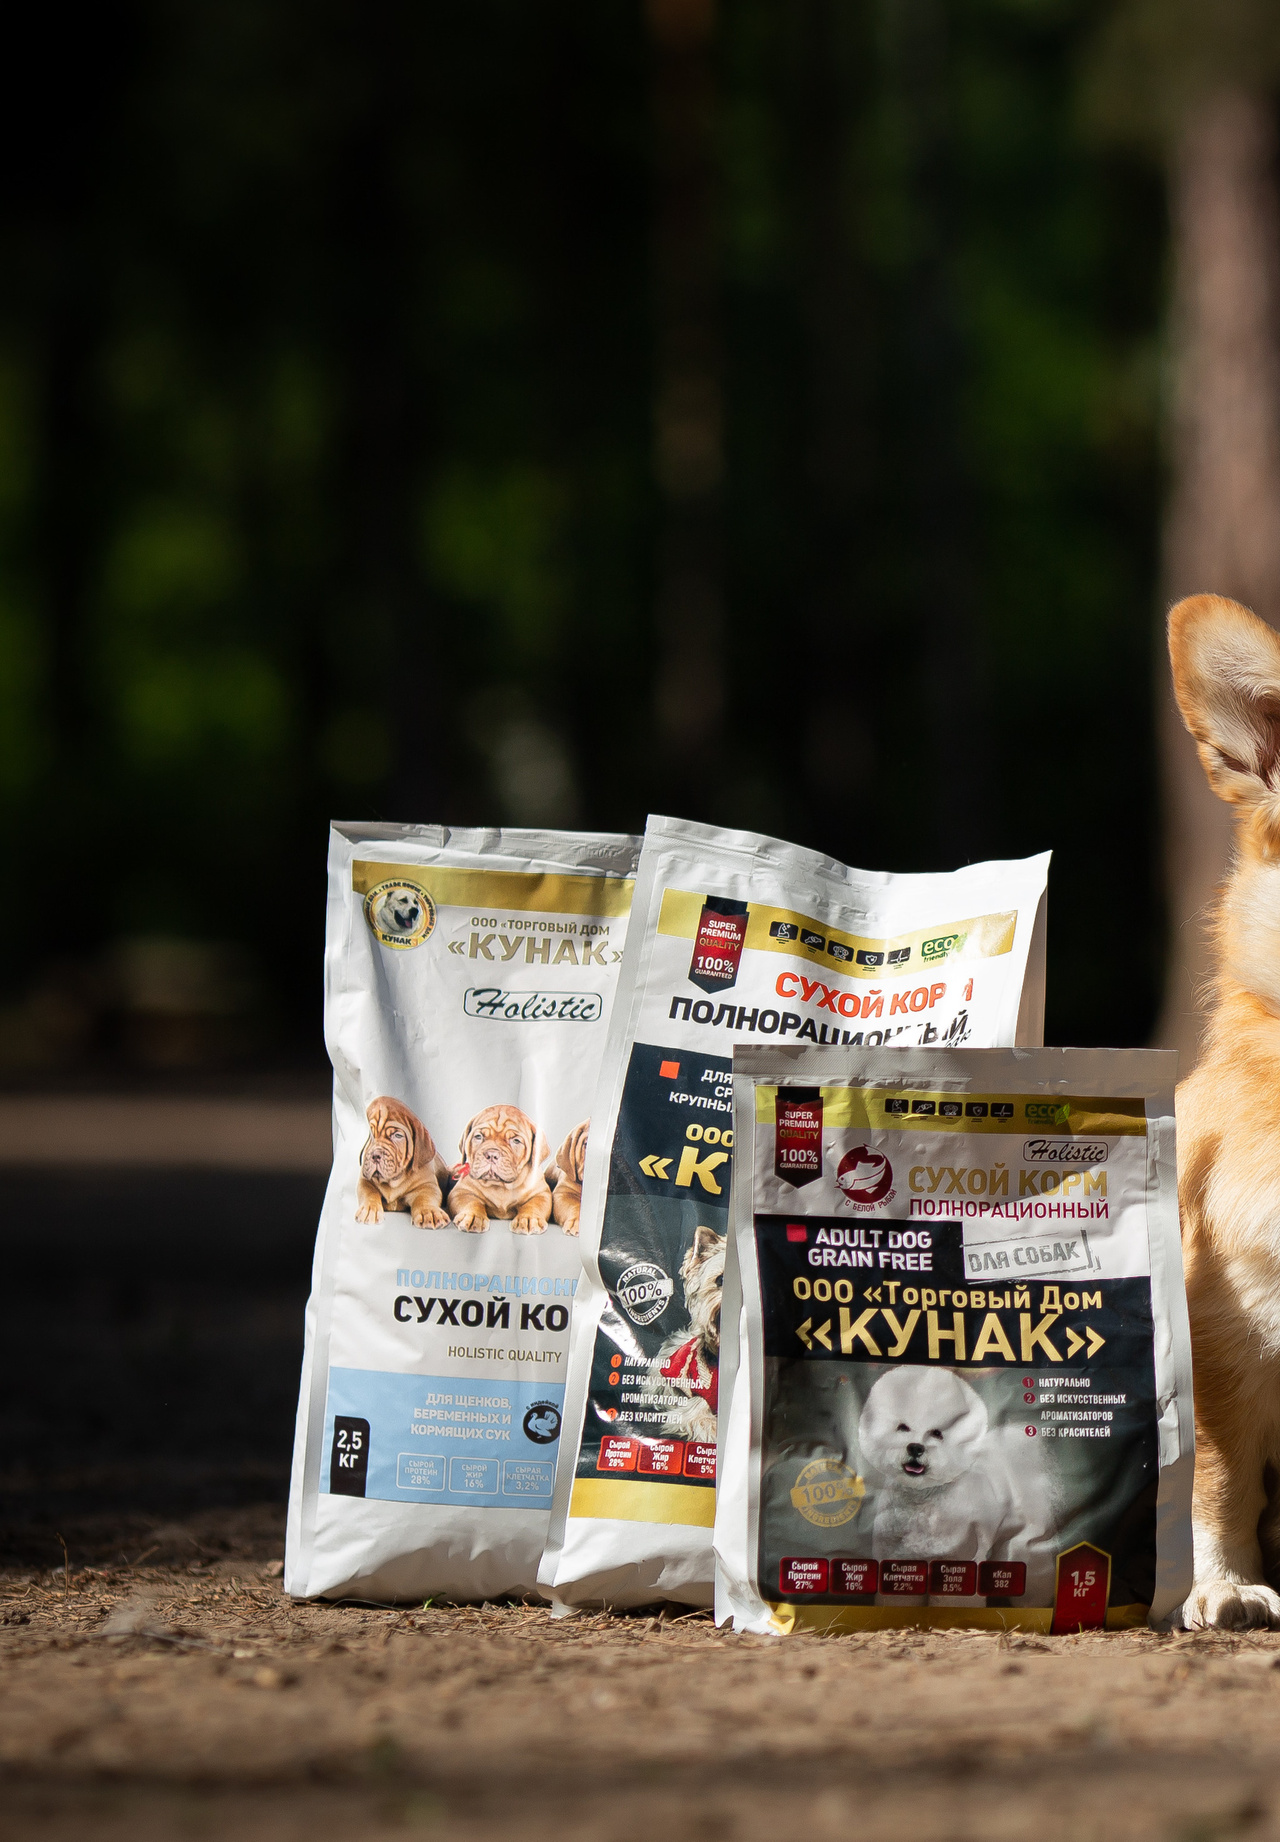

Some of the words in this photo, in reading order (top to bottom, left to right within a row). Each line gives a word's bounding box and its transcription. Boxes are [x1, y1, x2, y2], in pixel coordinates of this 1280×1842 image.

[471, 917, 497, 928] ООО
[501, 919, 577, 934] «ТОРГОВЫЙ
[579, 925, 610, 937] ДОМ
[709, 920, 736, 931] SUPER
[382, 934, 411, 945] КУНАК
[701, 927, 741, 941] PREMIUM
[447, 932, 623, 966] «КУНАК»
[699, 938, 740, 951] QUALITY
[923, 936, 954, 954] eco
[697, 956, 734, 973] 100%
[695, 968, 732, 979] GUARANTEED
[775, 972, 884, 1019] СУХОЙ
[472, 988, 596, 1020] Holistic
[701, 1069, 733, 1084] ДЛЯ
[669, 1091, 733, 1113] КРУПНЫ
[785, 1111, 812, 1120] SUPER
[1027, 1105, 1058, 1117] eco
[779, 1120, 819, 1129] PREMIUM
[780, 1130, 819, 1139] QUALITY
[780, 1149, 818, 1163] 100%
[1027, 1139, 1105, 1162] Holistic
[908, 1162, 1009, 1196] СУХОЙ
[1019, 1169, 1108, 1197] КОРМ
[852, 1203, 875, 1212] БЕЛОЙ
[878, 1189, 898, 1208] РЫБОЙ
[909, 1198, 1109, 1221] ПОЛНОРАЦИОННЫЙ
[816, 1228, 883, 1248] ADULT
[888, 1231, 932, 1249] DOG
[1013, 1240, 1080, 1266] СОБАК
[808, 1248, 872, 1267] GRAIN
[878, 1252, 933, 1271] FREE
[622, 1266, 657, 1283] NATURAL
[621, 1282, 662, 1305] 100%
[793, 1276, 854, 1304] ООО
[863, 1281, 1031, 1312] «Торговый
[1040, 1285, 1103, 1314] Дом
[394, 1295, 510, 1328] СУХОЙ
[629, 1299, 666, 1323] INGREDIENTS
[795, 1307, 1106, 1362] «КУНАК»
[448, 1346, 504, 1360] HOLISTIC
[508, 1349, 562, 1363] QUALITY
[624, 1357, 670, 1369] НАТУРАЛЬНО
[621, 1375, 635, 1385] БЕЗ
[636, 1376, 703, 1389] ИСКУССТВЕННЫХ
[1039, 1378, 1090, 1388] НАТУРАЛЬНО
[426, 1393, 453, 1406] ДЛЯ
[455, 1396, 512, 1410] ЩЕНКОВ,
[621, 1393, 688, 1406] АРОМАТИЗАТОРОВ
[1040, 1394, 1055, 1404] БЕЗ
[1057, 1394, 1126, 1404] ИСКУССТВЕННЫХ
[414, 1408, 500, 1425] БЕРЕМЕННЫХ
[502, 1414, 511, 1425] И
[620, 1411, 633, 1421] БЕЗ
[1041, 1411, 1113, 1421] АРОМАТИЗАТОРОВ
[411, 1424, 483, 1440] КОРМЯЩИХ
[486, 1429, 511, 1440] СУК
[1041, 1428, 1055, 1437] БЕЗ
[1059, 1426, 1111, 1437] КРАСИТЕЛЕЙ
[337, 1430, 362, 1451] 2,5
[609, 1440, 630, 1450] Сырой
[605, 1450, 632, 1459] Протеин
[653, 1453, 669, 1462] Жир
[409, 1460, 434, 1468] СЫРОЙ
[462, 1464, 487, 1472] СЫРОЙ
[609, 1459, 624, 1467] 28%
[652, 1462, 668, 1470] 16%
[405, 1467, 438, 1476] ПРОТЕИН
[516, 1466, 541, 1474] СЫРАЯ
[700, 1465, 713, 1474] 5%
[411, 1475, 431, 1485] 28%
[506, 1473, 550, 1482] КЛЕТЧАТКА
[464, 1479, 484, 1488] 16%
[516, 1482, 539, 1491] 3,2%
[802, 1481, 853, 1503] 100%
[792, 1561, 818, 1571] Сырой
[842, 1563, 868, 1572] Сырой
[891, 1564, 917, 1573] Сырая
[940, 1565, 966, 1574] Сырая
[788, 1571, 821, 1580] Протеин
[845, 1573, 863, 1582] Жир
[883, 1573, 924, 1582] Клетчатка
[943, 1575, 963, 1583] Зола
[992, 1571, 1012, 1579] кКал
[1071, 1571, 1096, 1588] 1,5
[795, 1581, 814, 1590] 27%
[893, 1583, 913, 1591] 2,2%
[942, 1583, 962, 1592] 8,5%
[994, 1580, 1009, 1588] 382
